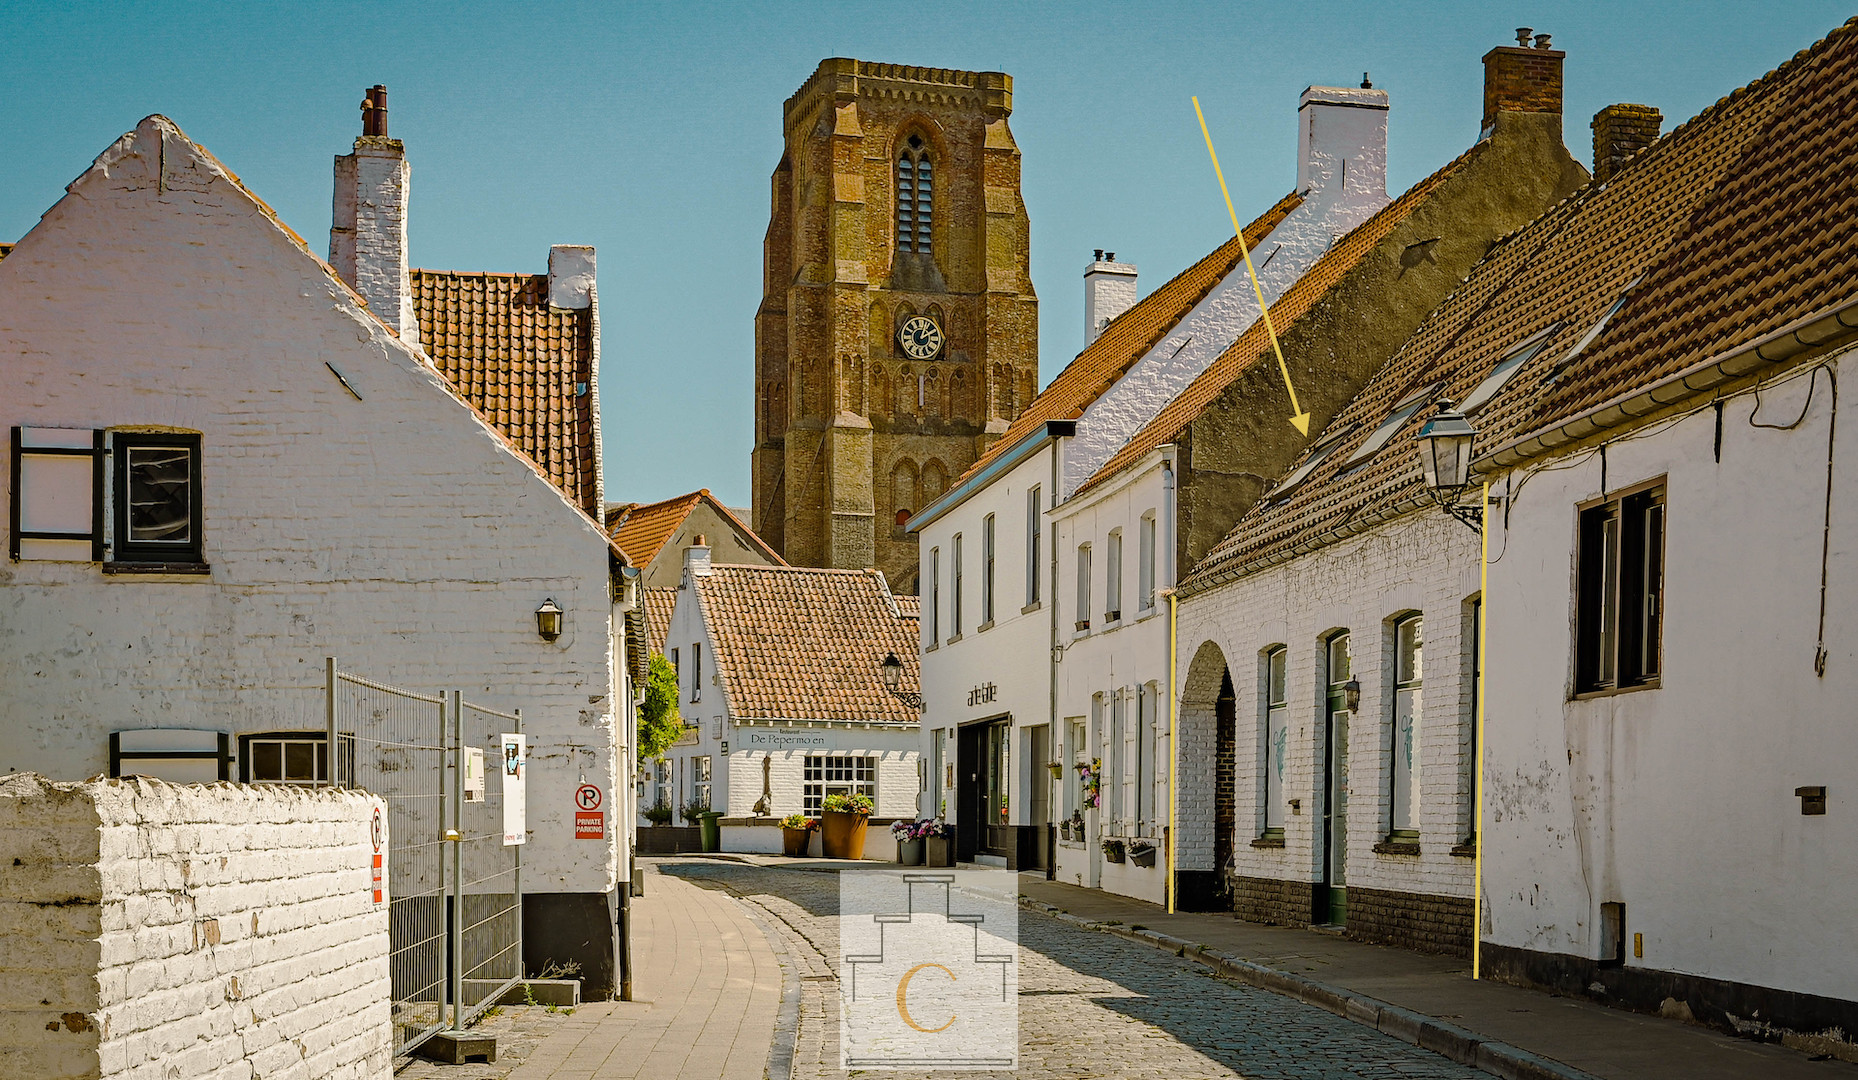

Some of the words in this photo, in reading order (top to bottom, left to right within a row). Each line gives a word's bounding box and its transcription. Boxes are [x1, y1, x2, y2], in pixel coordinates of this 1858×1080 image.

[751, 734, 766, 744] De
[768, 734, 825, 749] Pepermoen
[576, 825, 603, 833] PARKING
